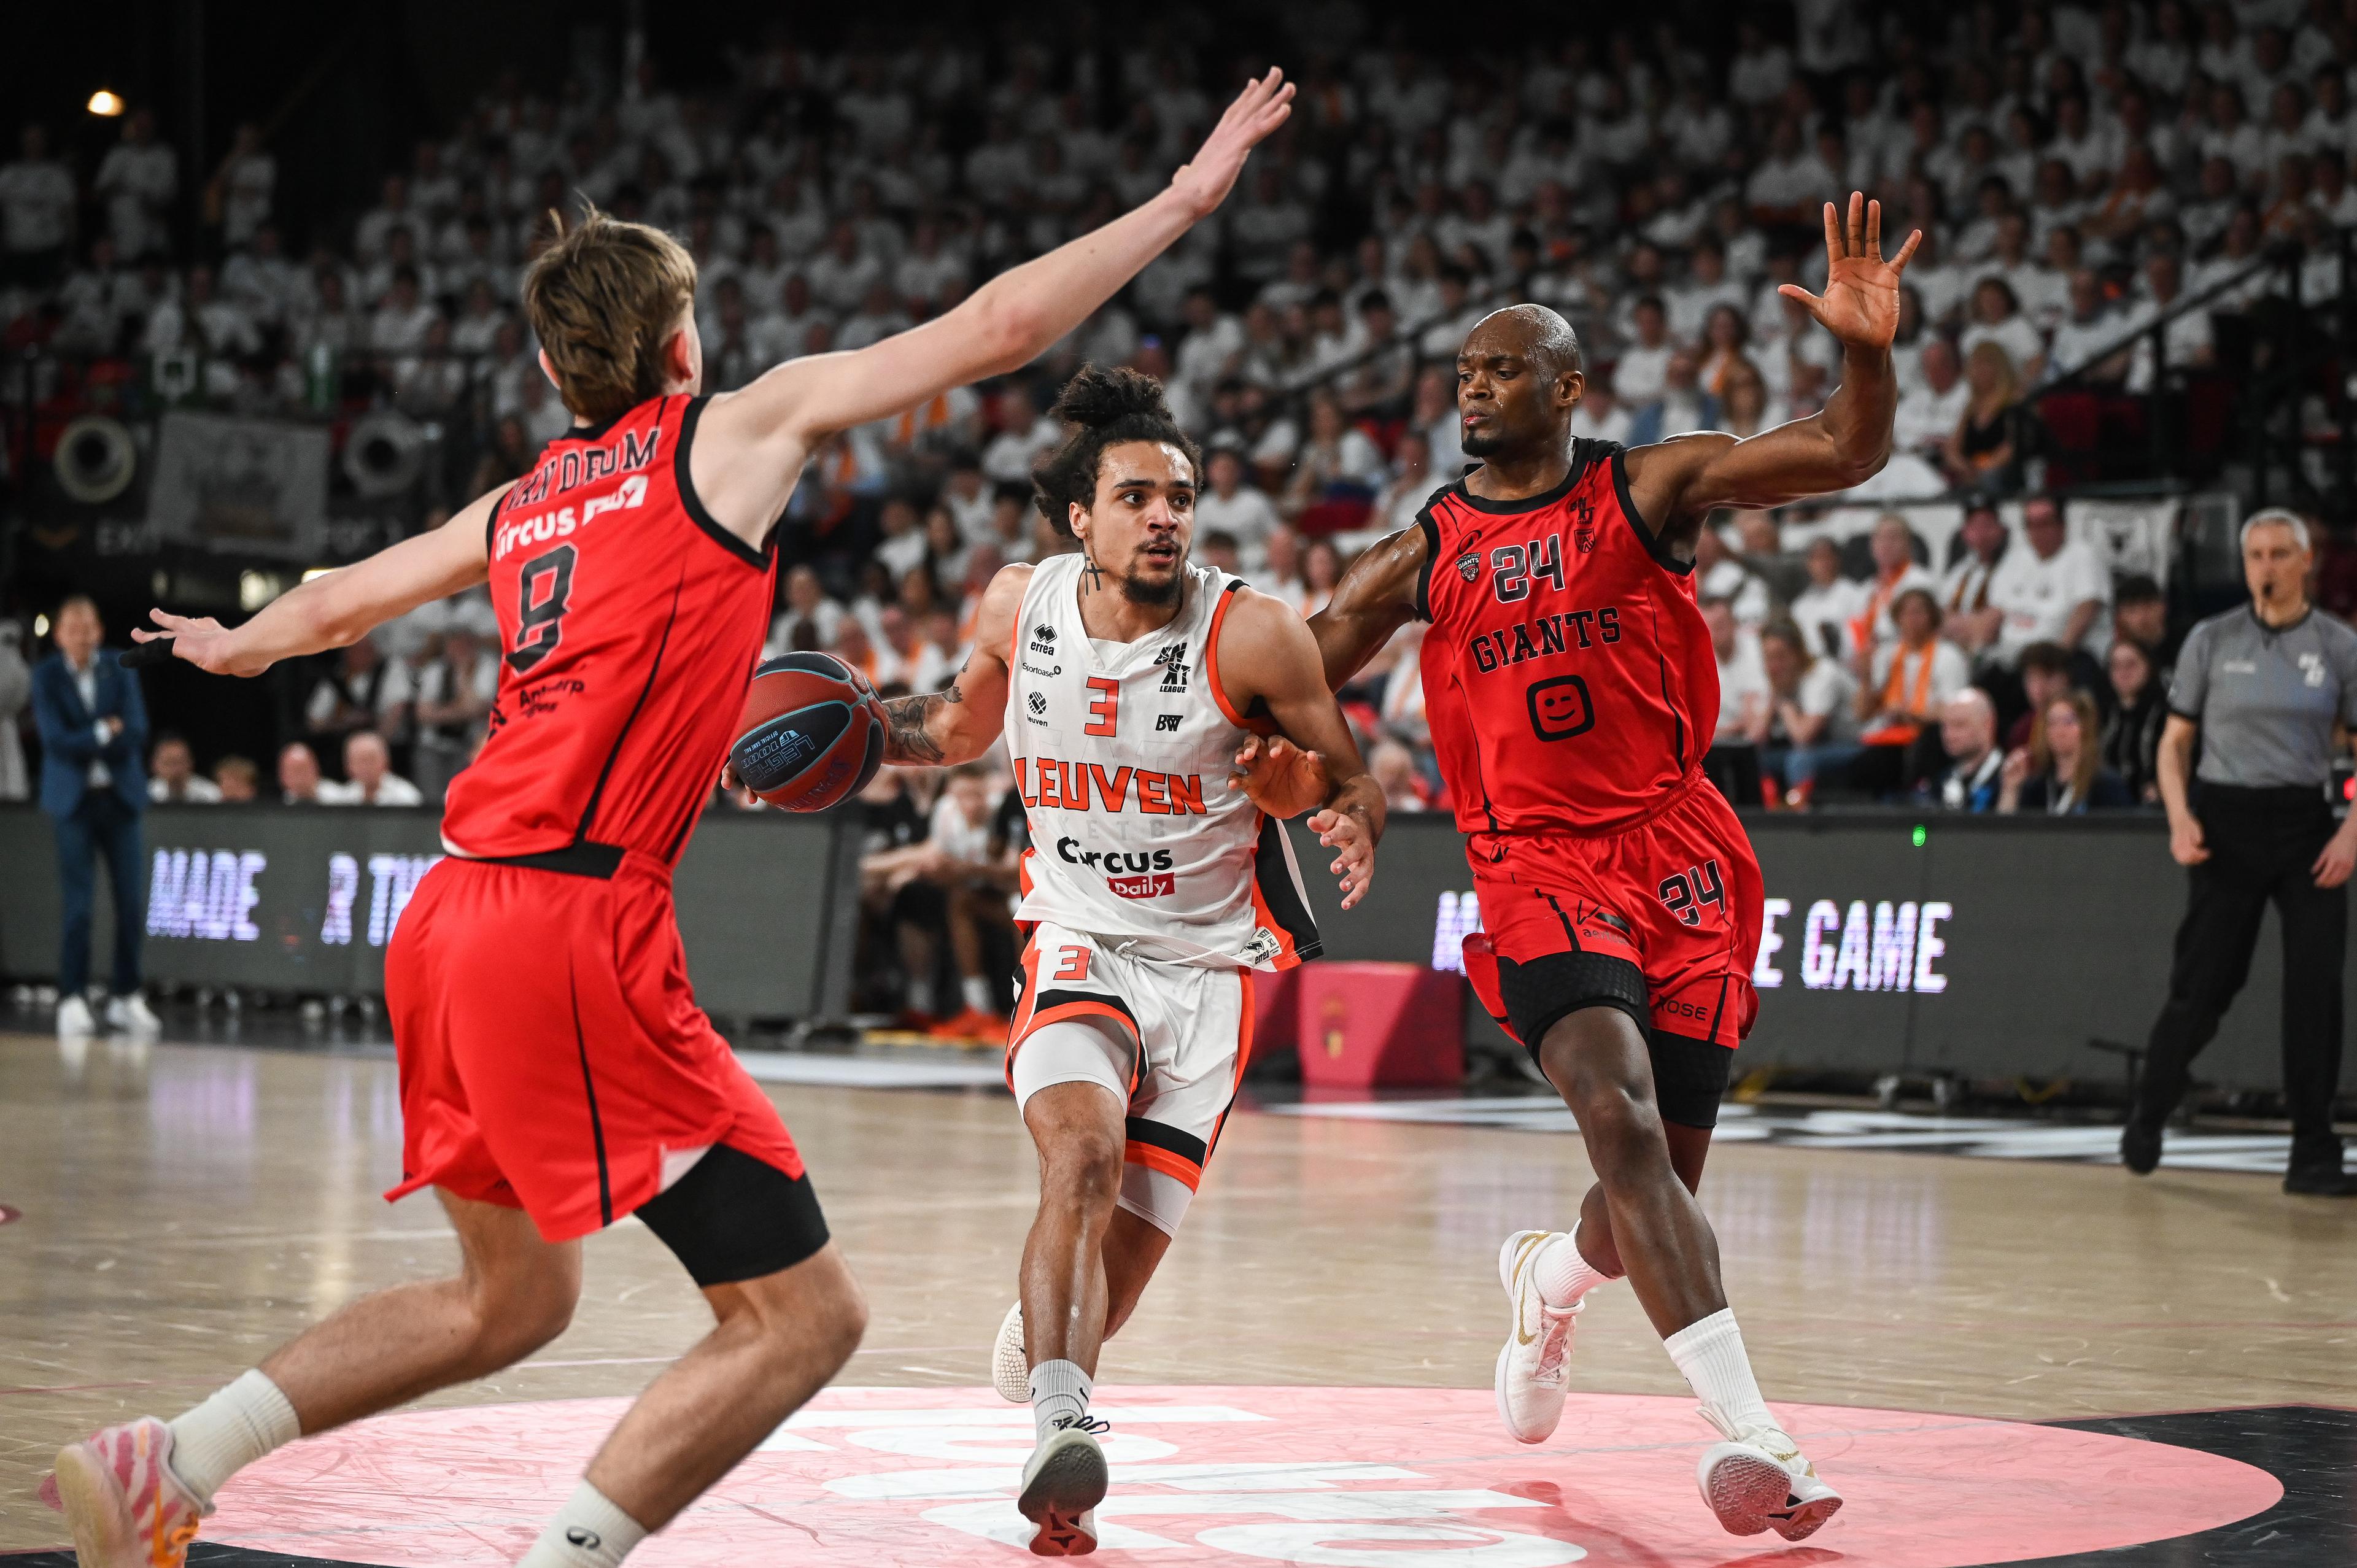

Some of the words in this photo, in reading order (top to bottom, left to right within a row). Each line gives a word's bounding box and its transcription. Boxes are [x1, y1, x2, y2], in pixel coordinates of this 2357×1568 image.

[1455, 552, 1481, 565] WINDROSE
[1458, 557, 1479, 570] GIANTS
[1490, 533, 1565, 604] 24
[505, 539, 579, 678] 8
[1469, 606, 1622, 674] GIANTS
[1022, 662, 1054, 678] Sportoase
[519, 679, 585, 709] Antrp
[1084, 676, 1119, 737] 3
[1027, 714, 1048, 727] leuven
[743, 746, 753, 755] BALL
[751, 741, 762, 750] GAME
[761, 730, 778, 745] OFFICIAL
[741, 741, 779, 769] 1000
[746, 735, 816, 780] LEGAC
[1014, 757, 1208, 815] LEUVEN
[1056, 836, 1173, 874] Circus
[146, 849, 268, 941] MADE
[368, 853, 447, 947] TH
[1115, 876, 1167, 898] Daily
[1657, 859, 1725, 927] 24
[1267, 938, 1277, 948] XL
[1801, 898, 1953, 993] GAME
[1053, 946, 1091, 981] 3
